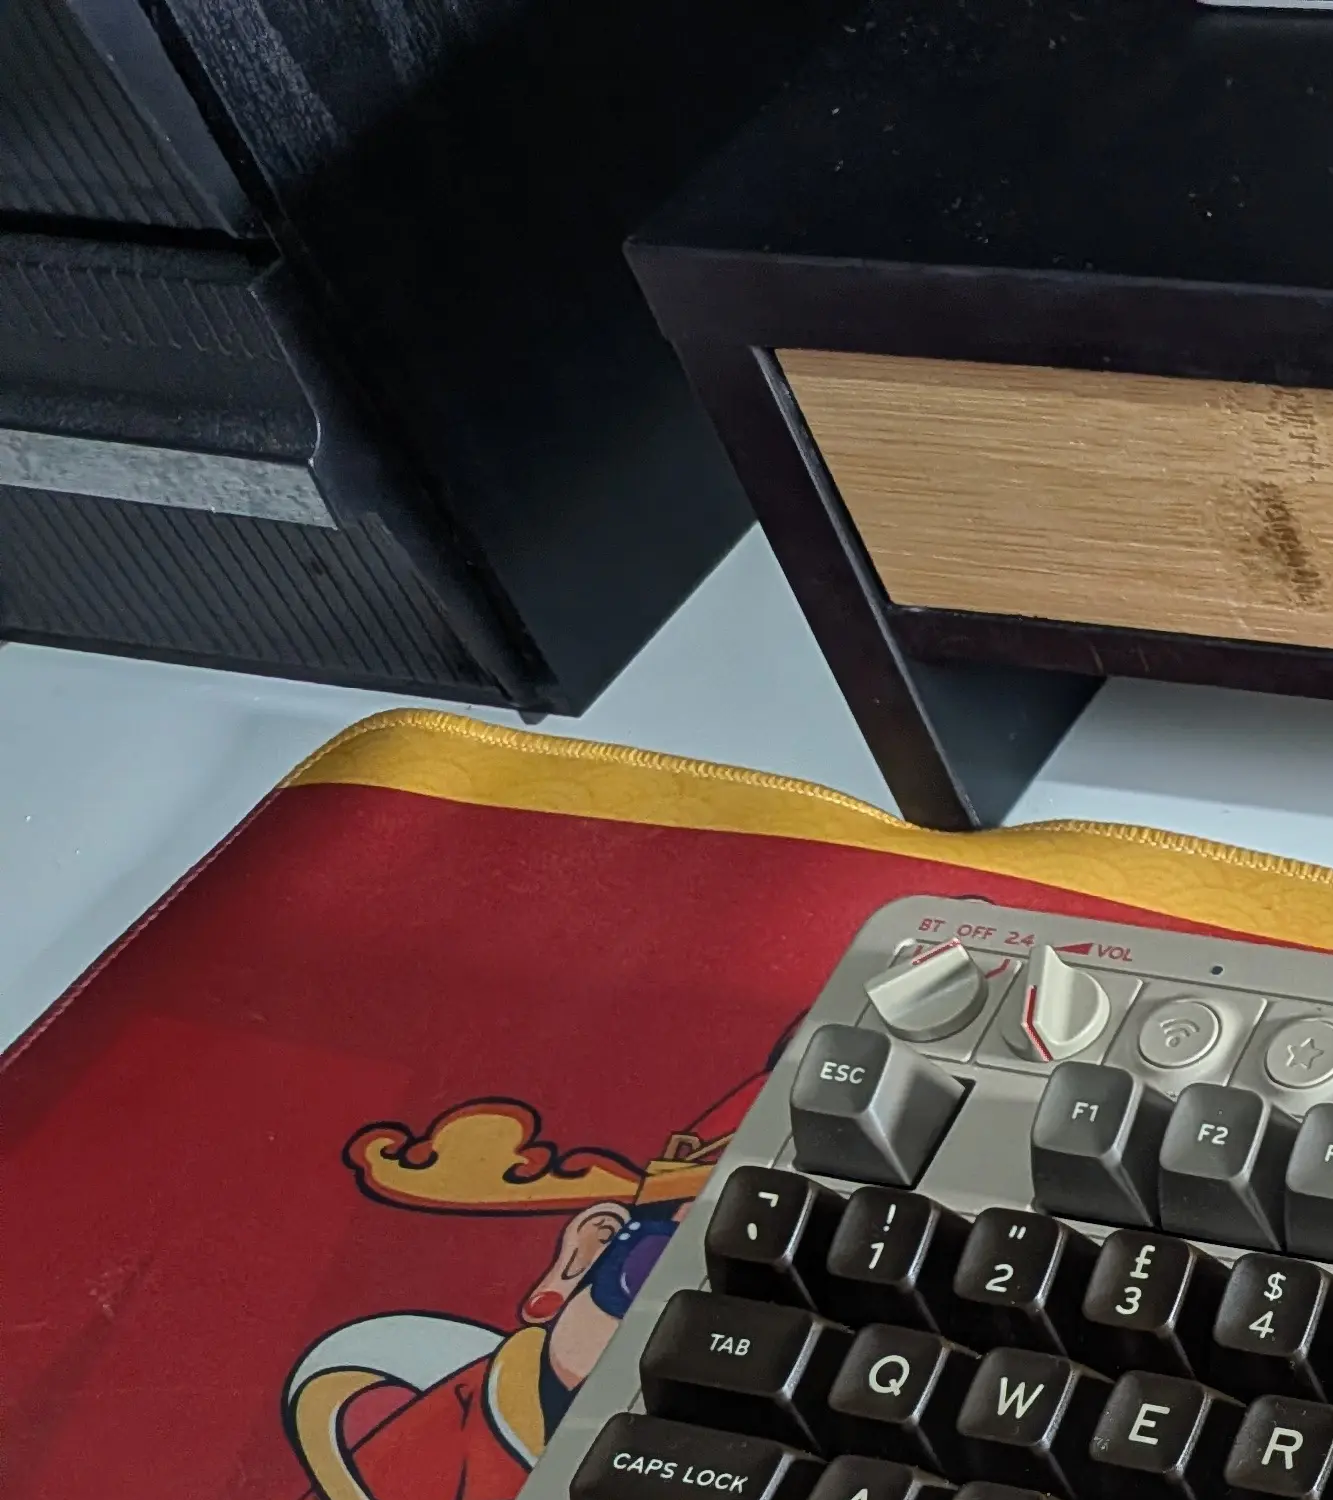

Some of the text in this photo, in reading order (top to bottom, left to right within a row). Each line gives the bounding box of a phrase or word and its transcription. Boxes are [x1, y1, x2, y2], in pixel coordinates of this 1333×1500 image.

[918, 918, 946, 931] BT
[957, 924, 997, 940] OFF
[1096, 943, 1134, 962] VOL
[819, 1061, 865, 1084] ESC
[1071, 1101, 1099, 1122] F1
[1197, 1123, 1229, 1145] F2
[883, 1203, 897, 1232] !
[868, 1242, 885, 1270] 1
[1129, 1244, 1156, 1279] £
[985, 1263, 1014, 1293] 2
[1263, 1271, 1287, 1302] $
[1115, 1286, 1142, 1315] 3
[1248, 1310, 1275, 1339] 4
[710, 1333, 751, 1356] TAB
[868, 1354, 910, 1397] Q
[997, 1376, 1045, 1419] W
[1128, 1403, 1171, 1445] E
[1261, 1426, 1304, 1470] R
[613, 1452, 749, 1494] CAPS LOCK
